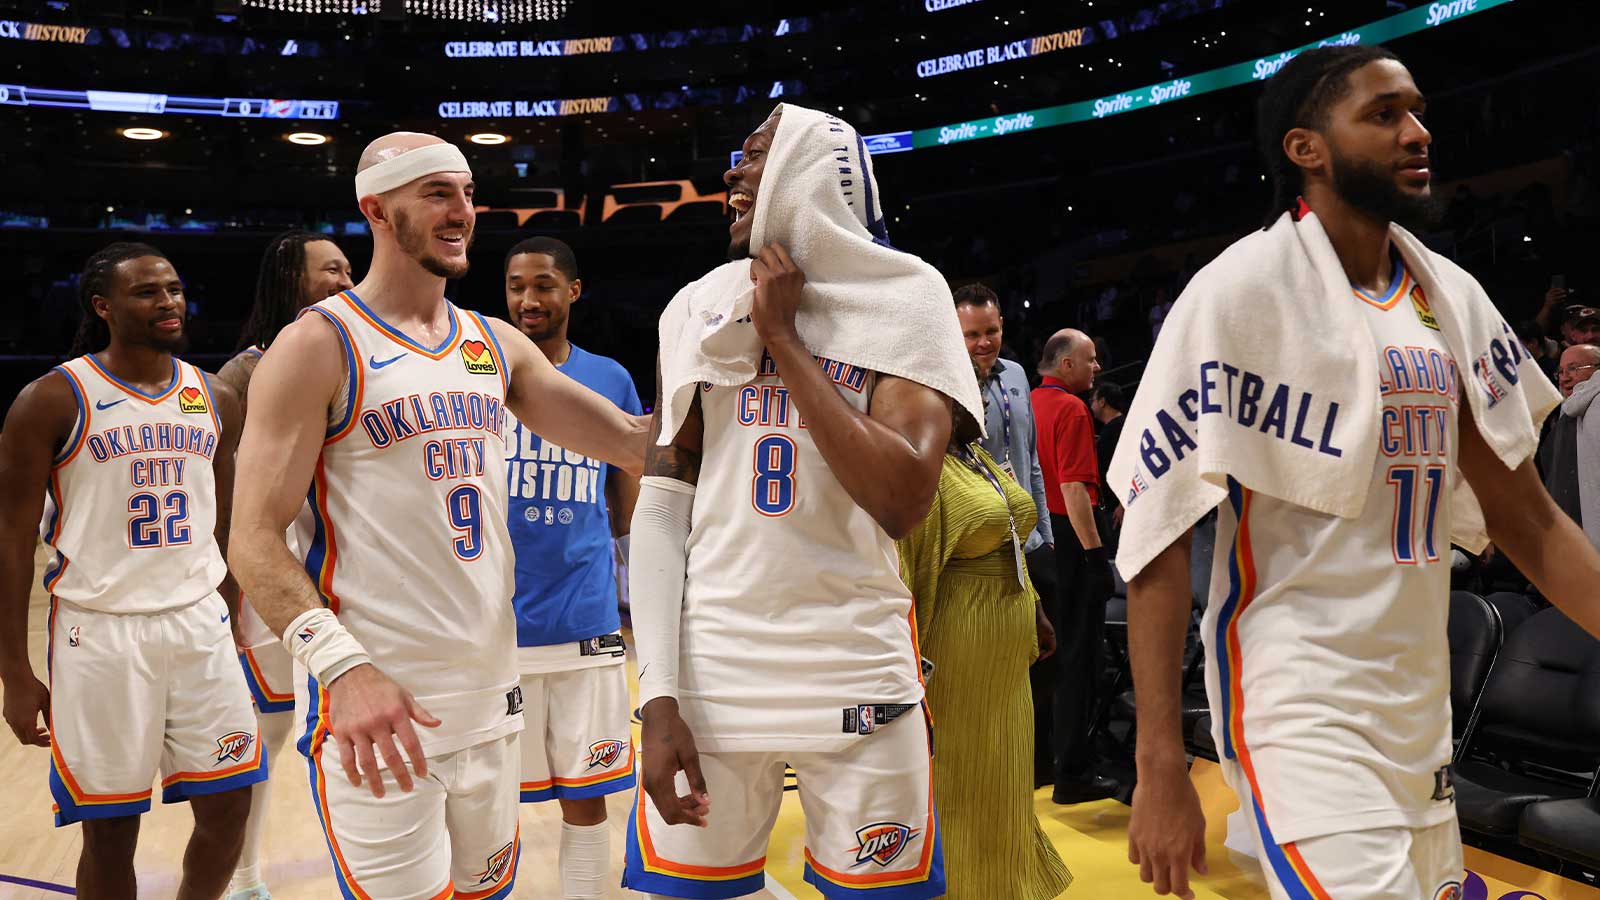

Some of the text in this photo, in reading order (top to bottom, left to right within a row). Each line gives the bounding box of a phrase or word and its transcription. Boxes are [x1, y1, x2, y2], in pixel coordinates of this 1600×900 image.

[24, 23, 91, 43] HISTORY
[445, 37, 615, 58] CELEBRATE BLACK HISTORY
[917, 27, 1086, 78] CELEBRATE BLACK HISTORY
[438, 97, 611, 118] CELEBRATE BLACK HISTORY
[1092, 94, 1133, 119] Sprite
[1149, 79, 1191, 104] Sprite
[937, 122, 976, 145] Sprite
[993, 112, 1034, 136] Sprite
[737, 384, 808, 428] CIT
[1140, 360, 1343, 480] BASETBALL
[87, 422, 218, 463] OKLAHOMA
[1381, 405, 1450, 457] CITY
[130, 456, 187, 488] CITY
[423, 437, 486, 481] CITY
[504, 455, 600, 505] ISTORY
[751, 433, 798, 518] 8
[127, 490, 193, 550] 22
[445, 483, 484, 562] 9
[1387, 463, 1447, 565] 11
[858, 829, 900, 860] OKC
